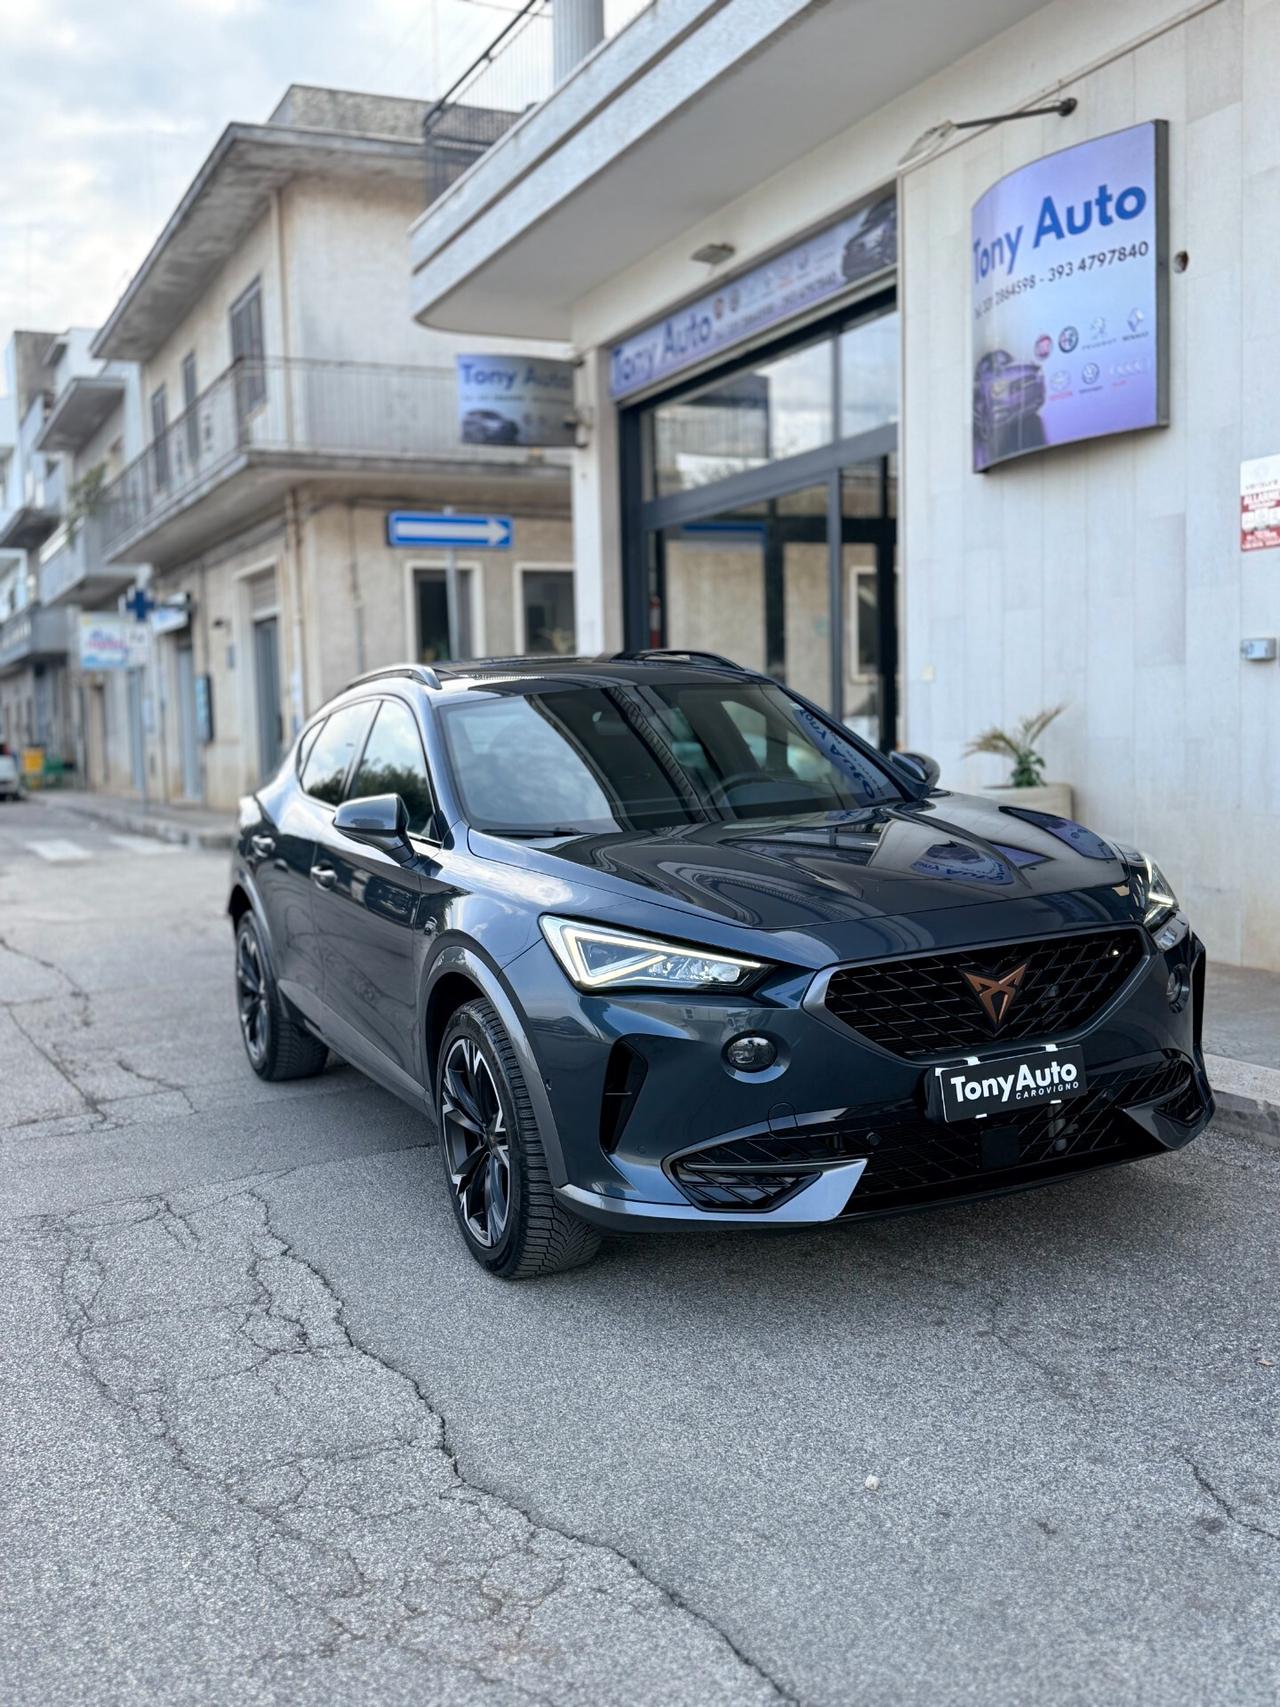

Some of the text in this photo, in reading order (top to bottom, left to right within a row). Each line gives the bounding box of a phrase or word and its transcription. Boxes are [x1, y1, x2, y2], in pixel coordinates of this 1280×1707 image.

[973, 184, 1147, 284] Tony Auto
[1048, 261, 1073, 283] 393
[1077, 240, 1149, 273] 4797840
[661, 309, 712, 363] Auto
[461, 363, 518, 392] Tony
[950, 1061, 1078, 1103] TonyAuto
[1016, 1081, 1079, 1100] CAROVIGNO
